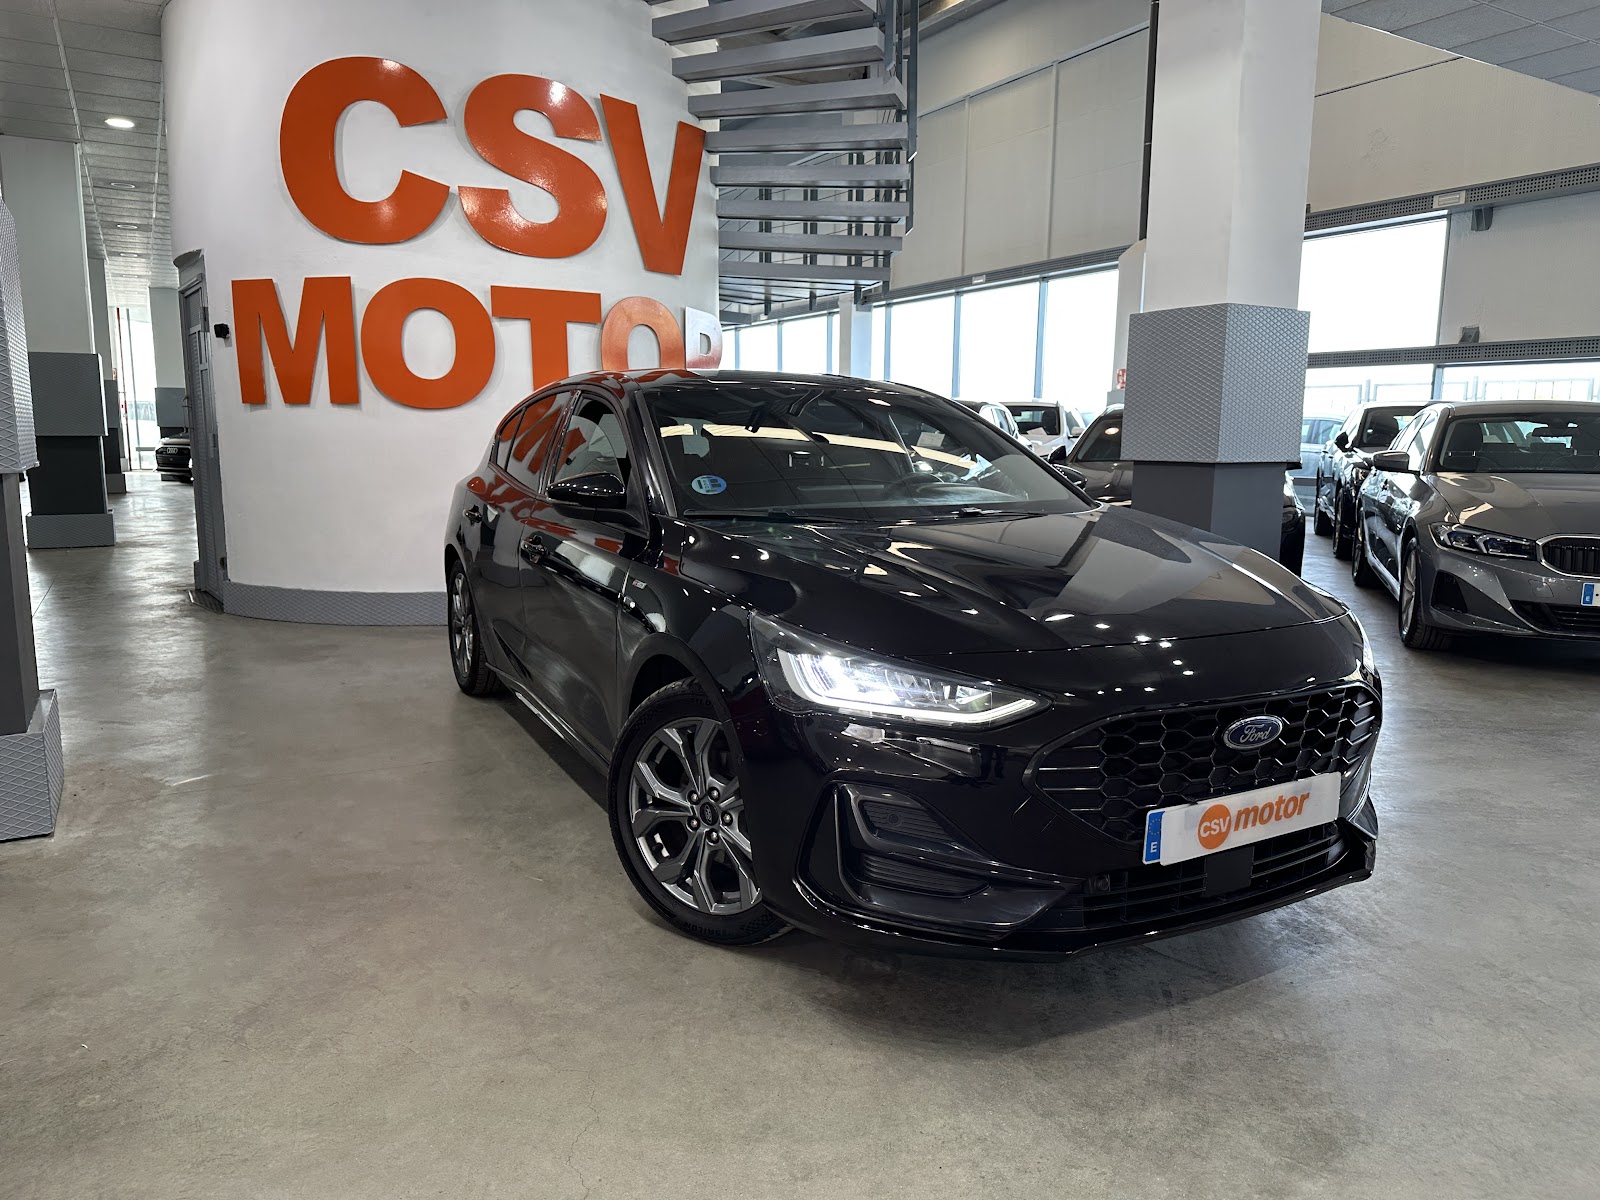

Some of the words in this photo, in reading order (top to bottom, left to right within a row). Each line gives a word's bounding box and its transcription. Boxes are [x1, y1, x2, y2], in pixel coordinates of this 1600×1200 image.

[280, 56, 706, 275] CSV
[1239, 723, 1271, 744] Ford
[1199, 816, 1230, 837] CSV
[1233, 792, 1310, 831] motor
[1150, 841, 1158, 853] E
